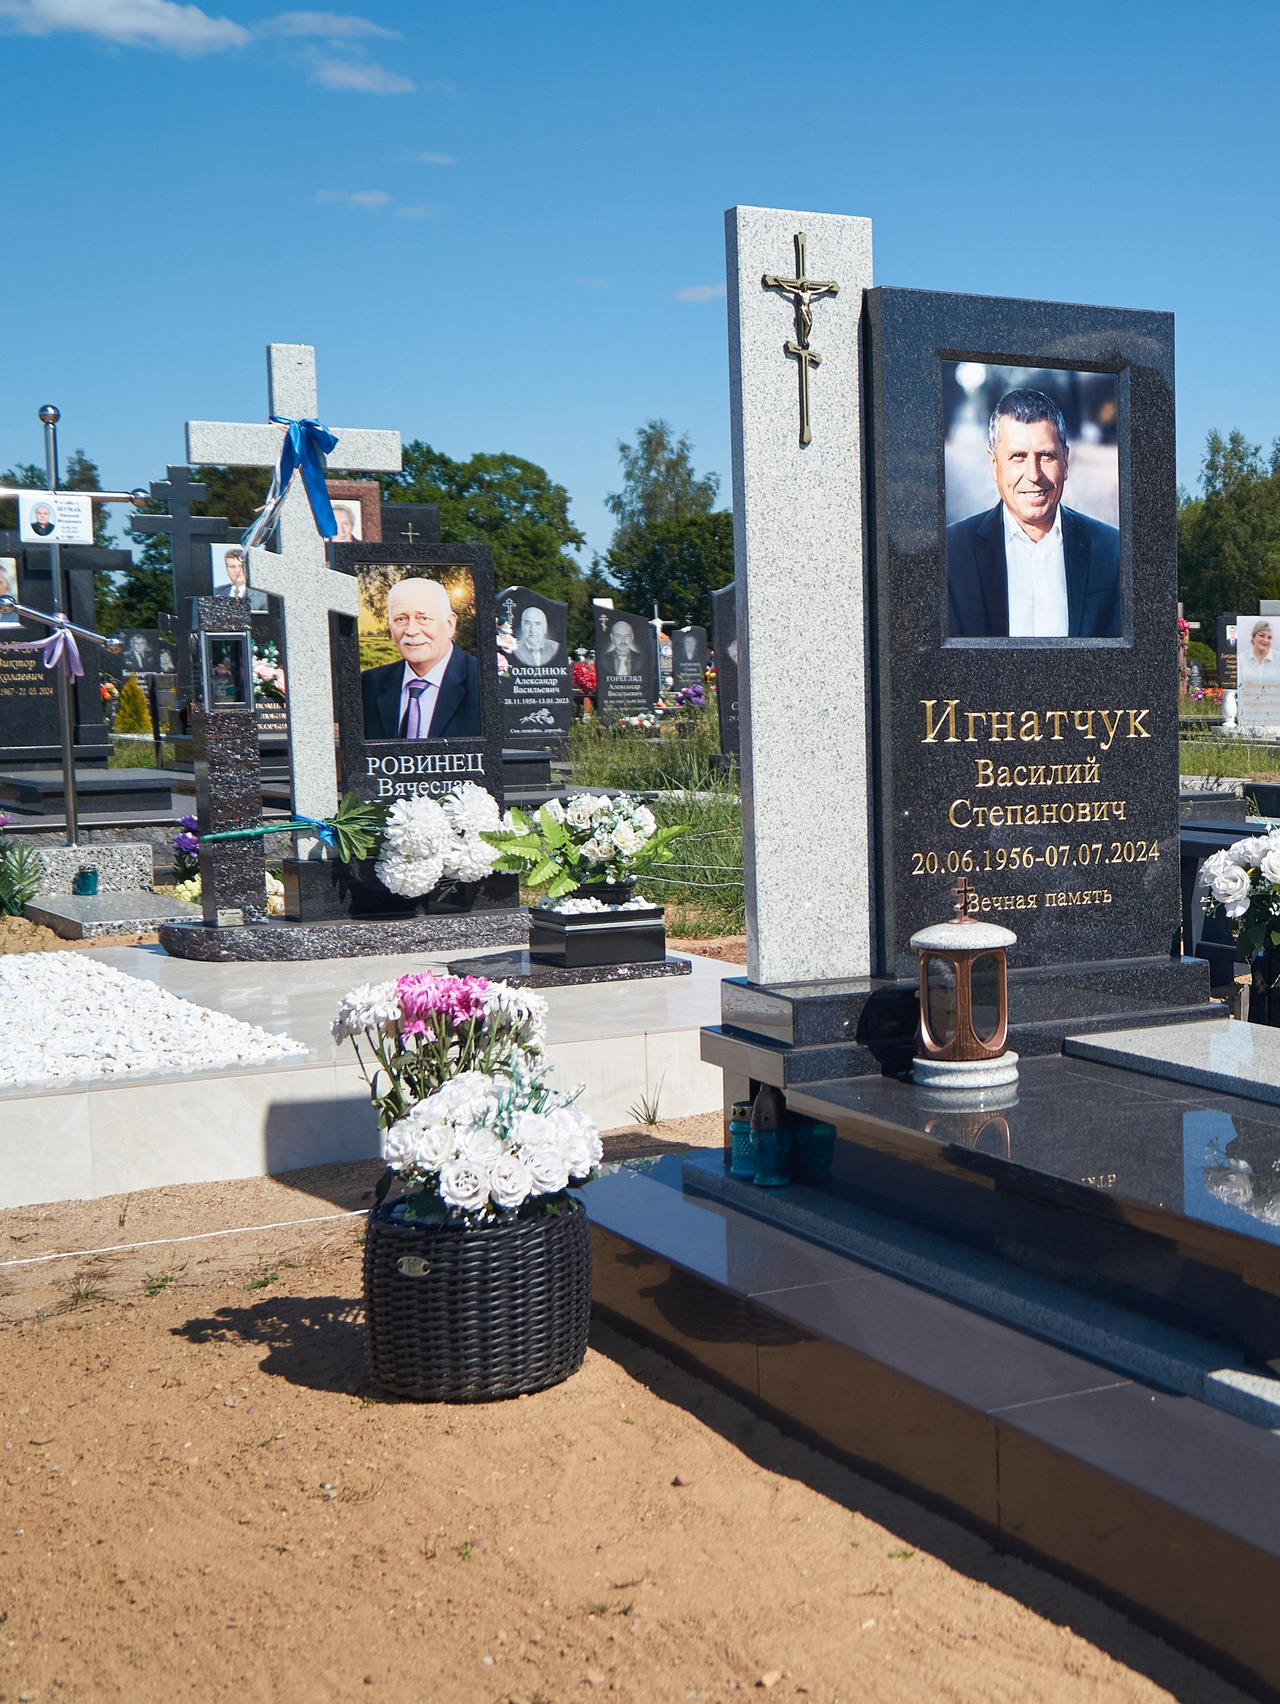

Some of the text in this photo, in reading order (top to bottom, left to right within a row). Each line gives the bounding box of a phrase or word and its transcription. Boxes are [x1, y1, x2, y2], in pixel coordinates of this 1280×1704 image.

[510, 666, 568, 677] ОЛОДНЮК
[514, 677, 558, 686] Александр
[513, 685, 560, 694] Васильевич
[920, 699, 1151, 750] Игнатчук
[365, 752, 485, 775] РОВИНЕЦ
[975, 756, 1101, 788] Василий
[949, 799, 1127, 828] Степанович
[911, 840, 1161, 875] 20.06.1956-07.07.2024
[967, 888, 1113, 913] Вечная память
